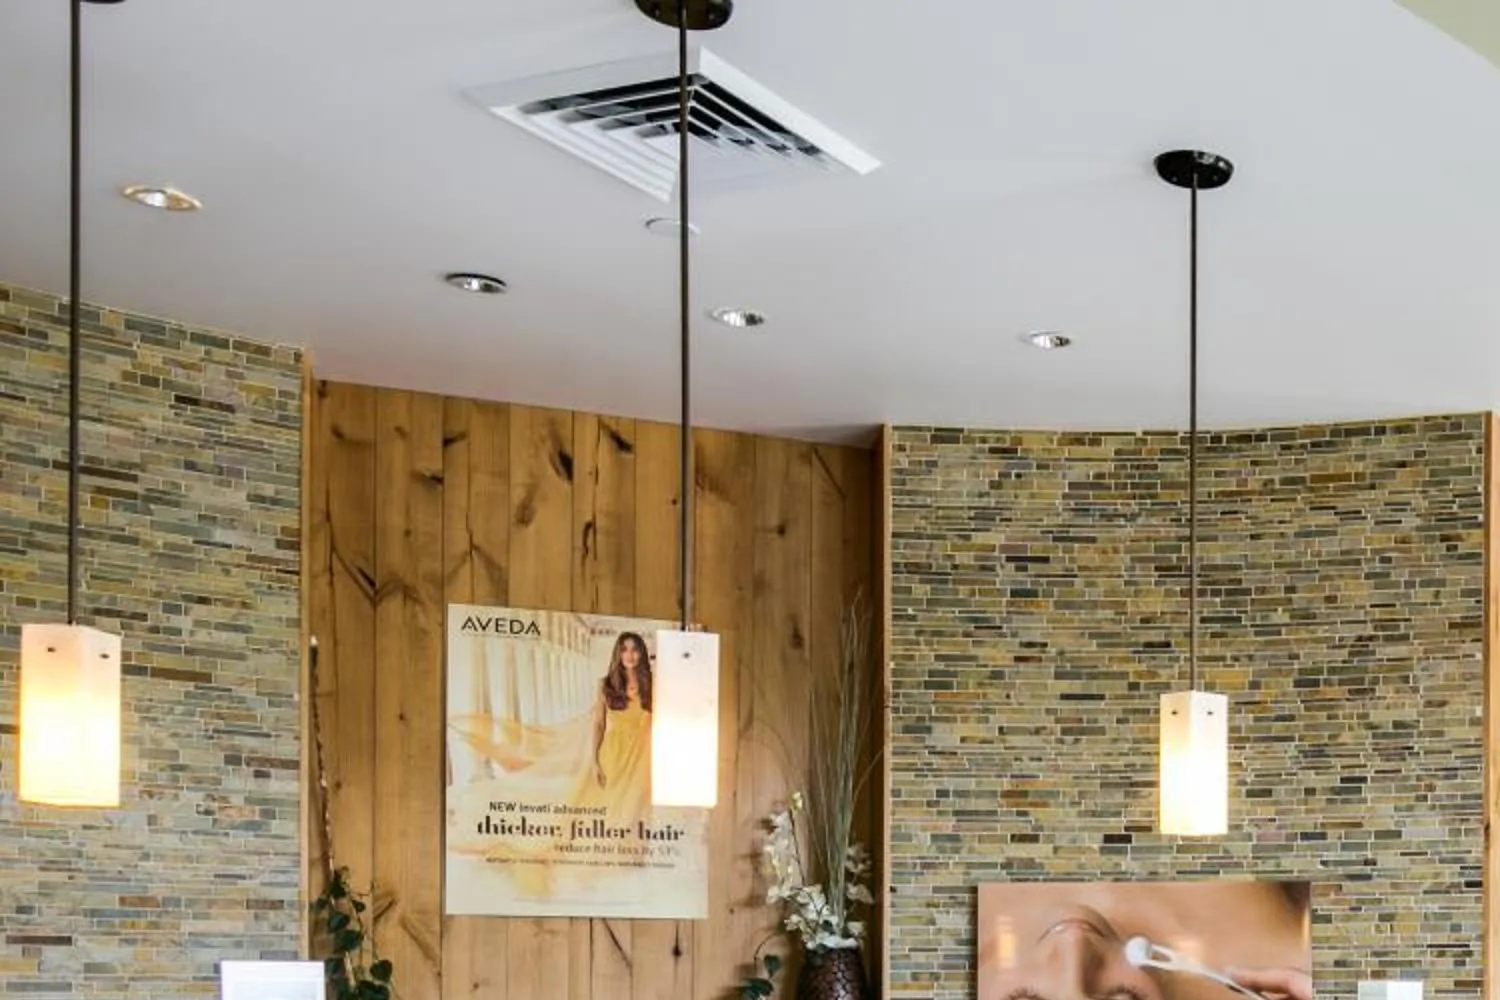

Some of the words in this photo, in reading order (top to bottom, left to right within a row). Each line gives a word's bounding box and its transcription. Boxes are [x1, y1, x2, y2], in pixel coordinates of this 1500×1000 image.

[461, 615, 541, 636] AVEDA
[489, 801, 516, 812] NEW
[570, 819, 632, 841] fuller
[638, 821, 685, 841] hair
